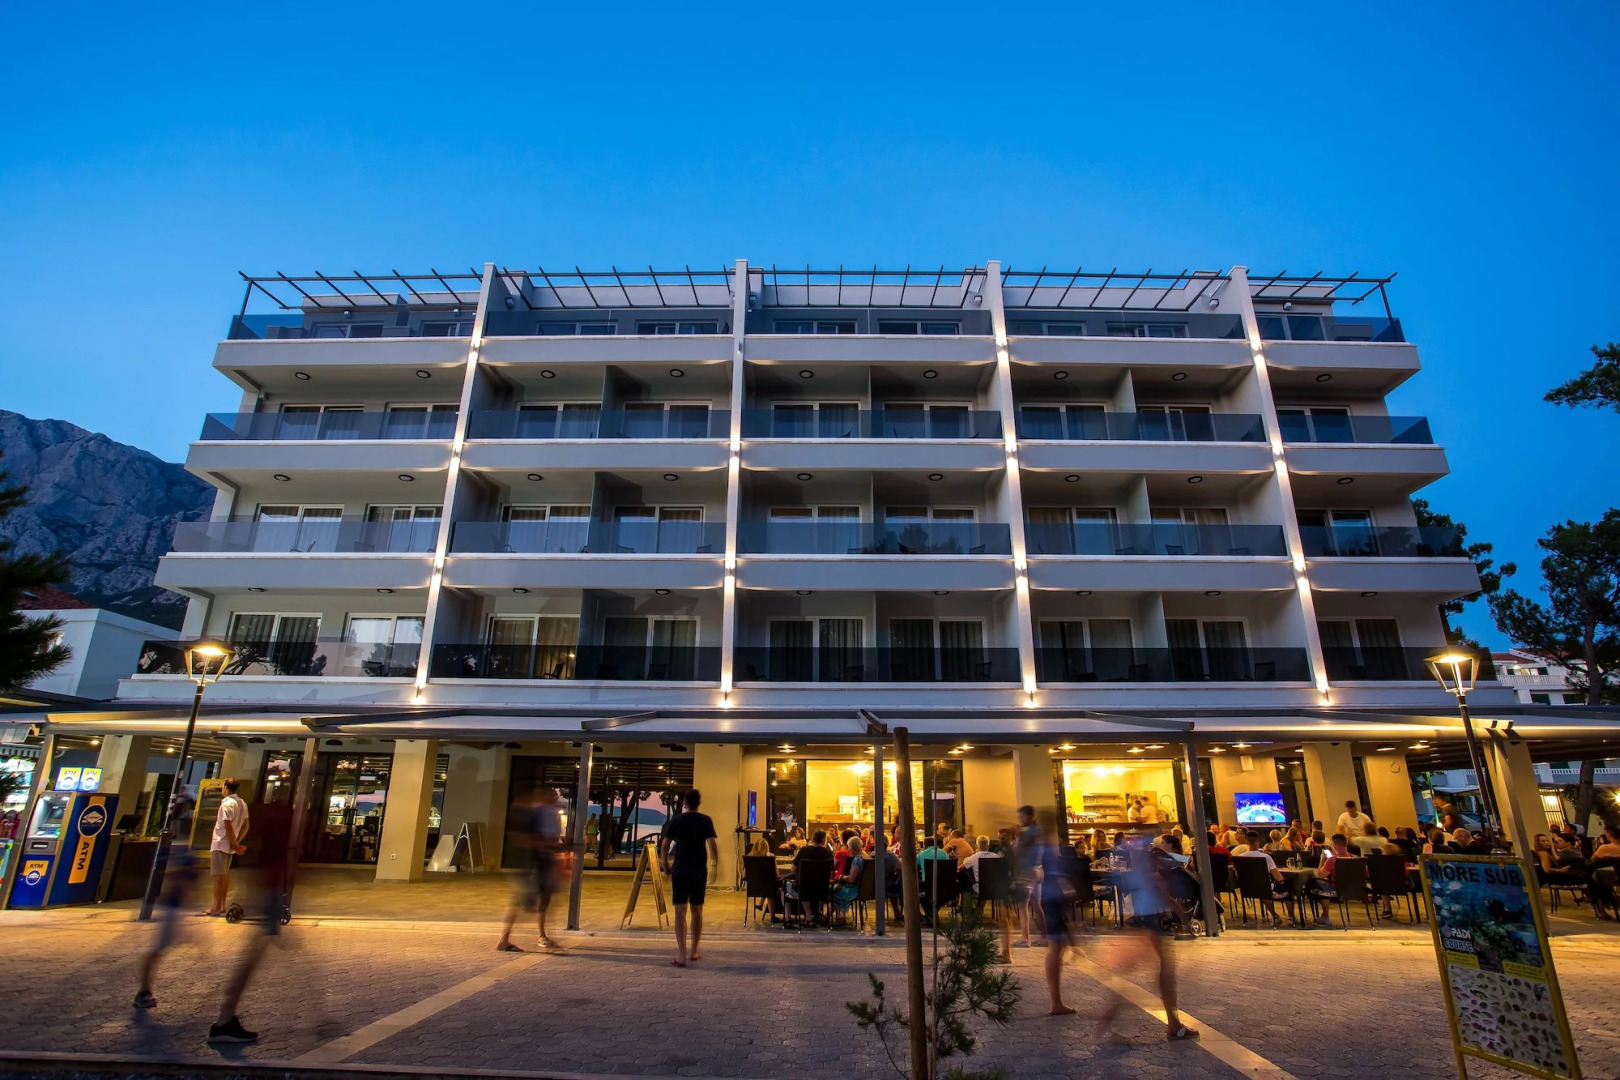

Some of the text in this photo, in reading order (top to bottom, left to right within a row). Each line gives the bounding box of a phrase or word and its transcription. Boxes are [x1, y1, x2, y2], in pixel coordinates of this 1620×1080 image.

[77, 841, 89, 870] ATM
[1429, 864, 1522, 886] MORE SUB
[1451, 927, 1471, 939] PADI
[1443, 938, 1474, 952] COURSE
